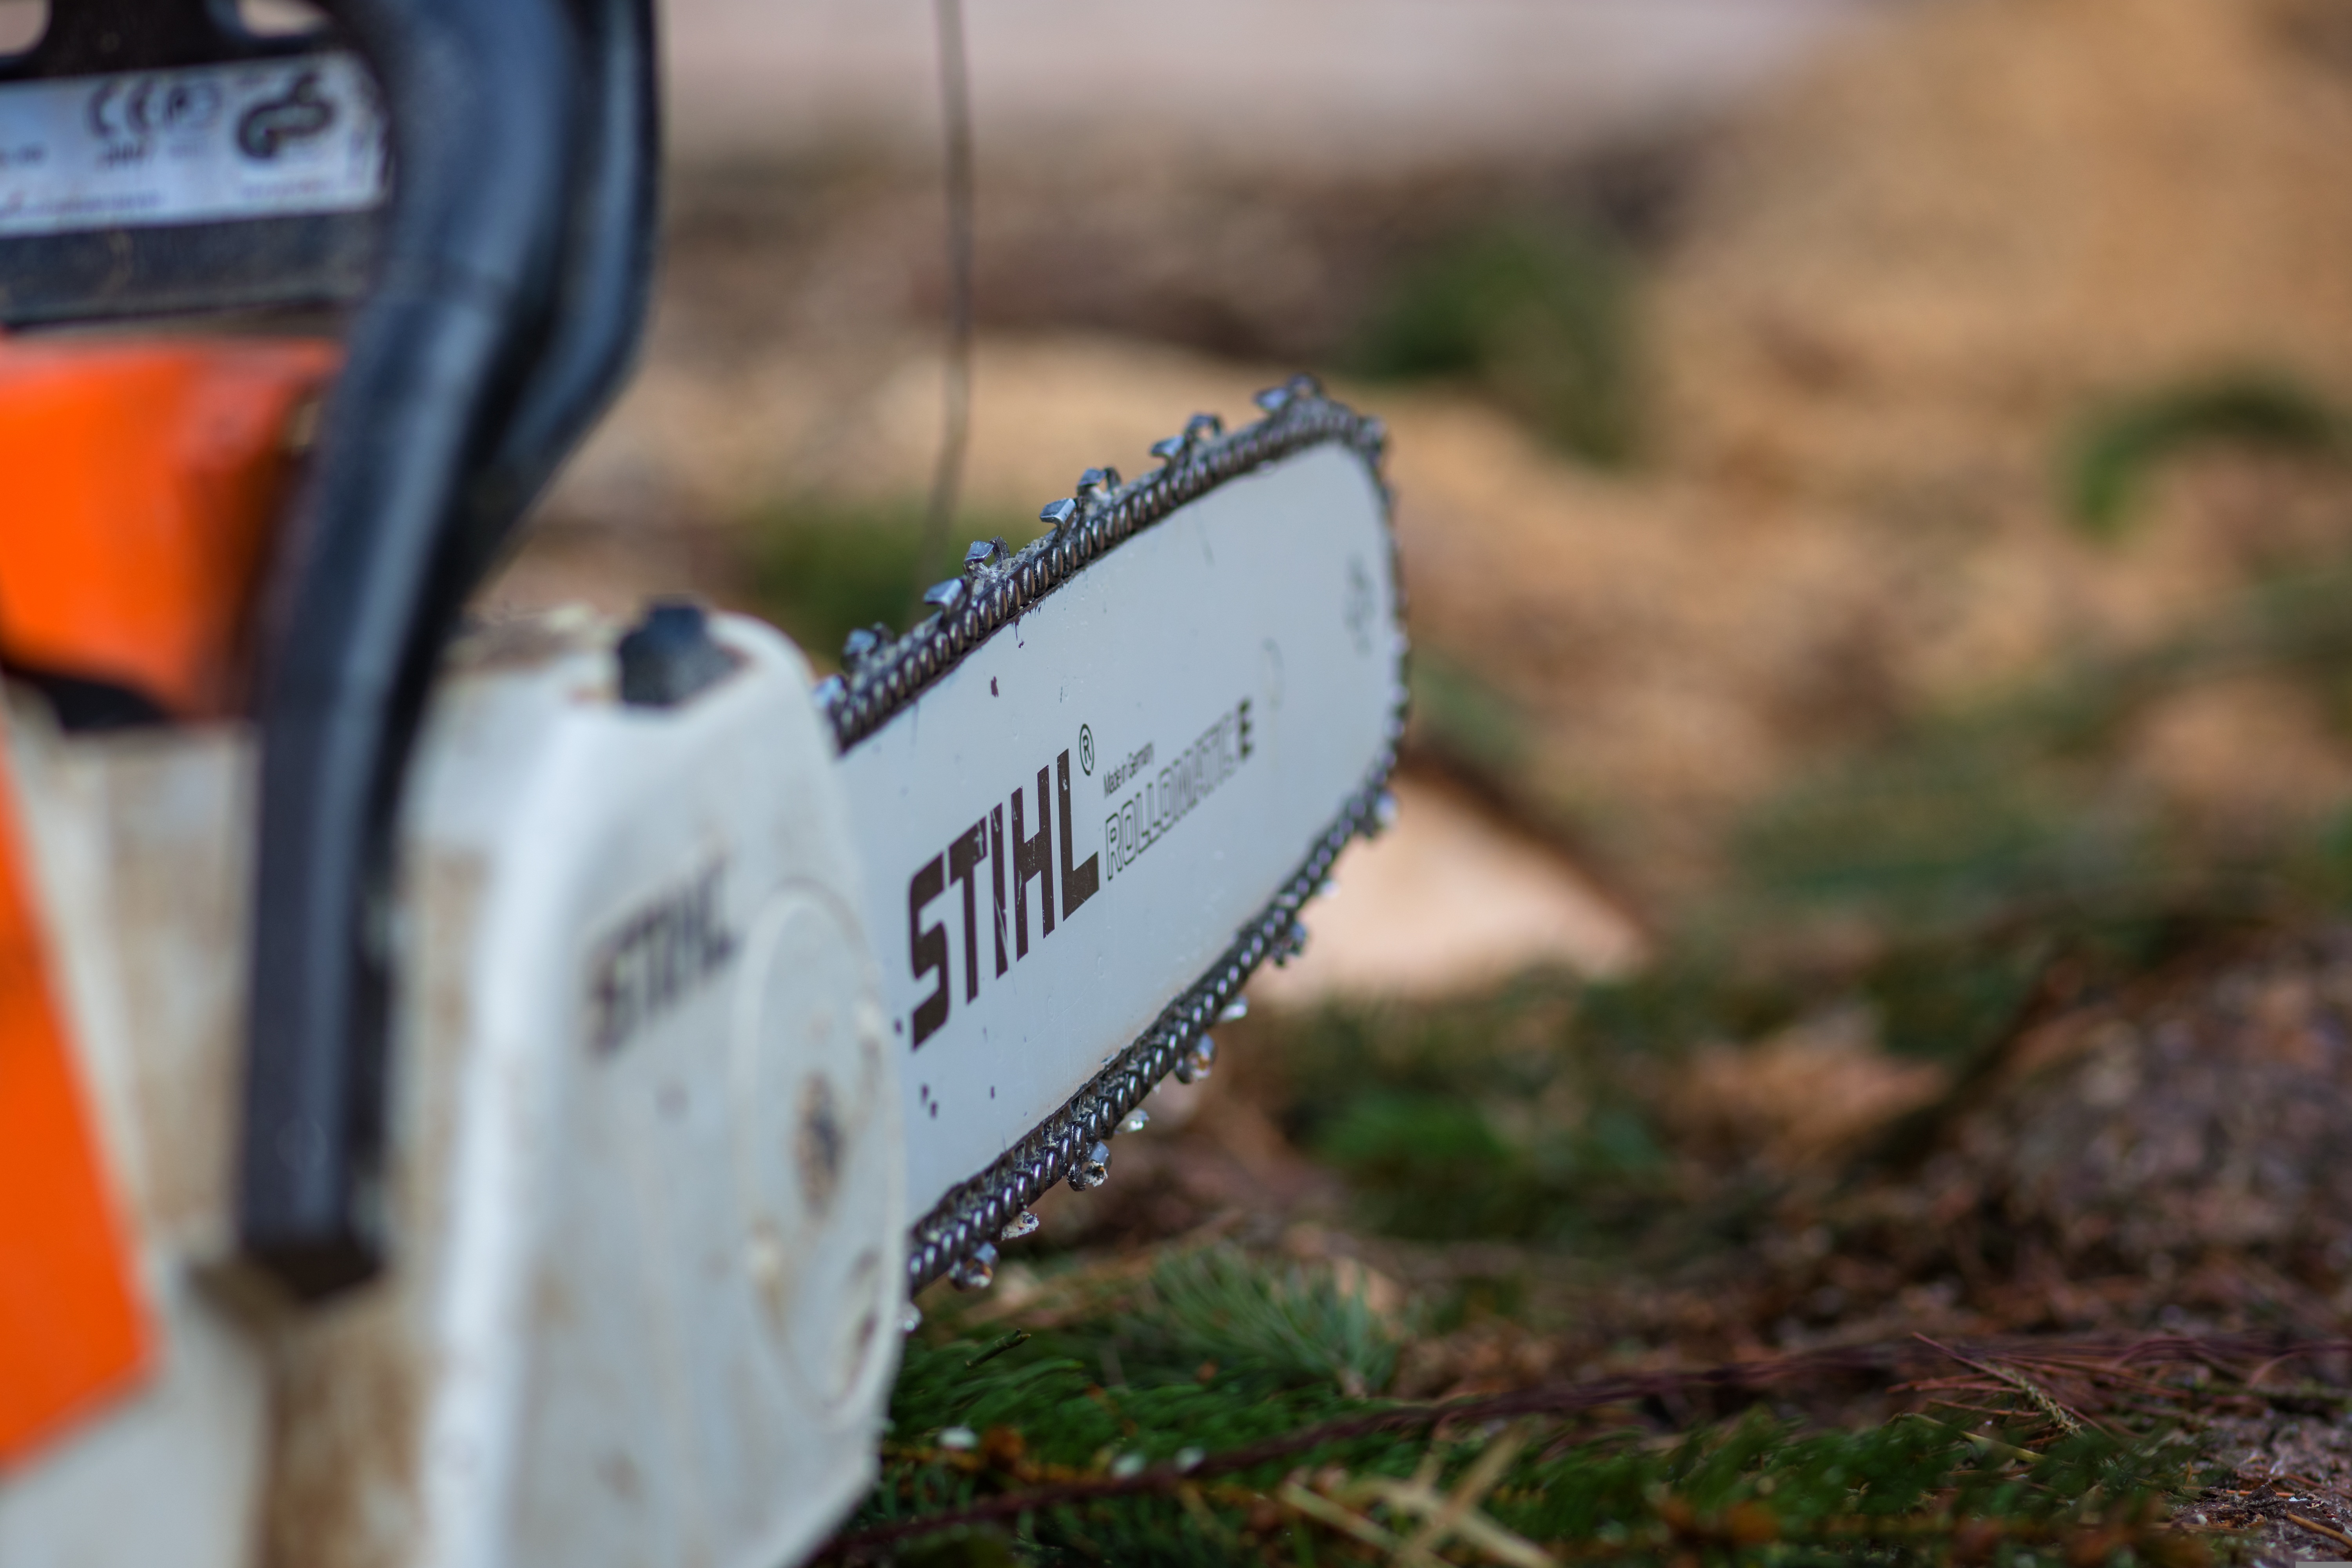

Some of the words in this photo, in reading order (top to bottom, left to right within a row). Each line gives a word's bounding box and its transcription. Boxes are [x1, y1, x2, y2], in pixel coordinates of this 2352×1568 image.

[1103, 765, 1121, 799] Made
[1121, 759, 1128, 784] in
[1128, 742, 1154, 779] Germany
[1105, 710, 1236, 881] ROLLOMATIC
[1236, 698, 1253, 762] E
[909, 748, 1099, 1051] STIHL
